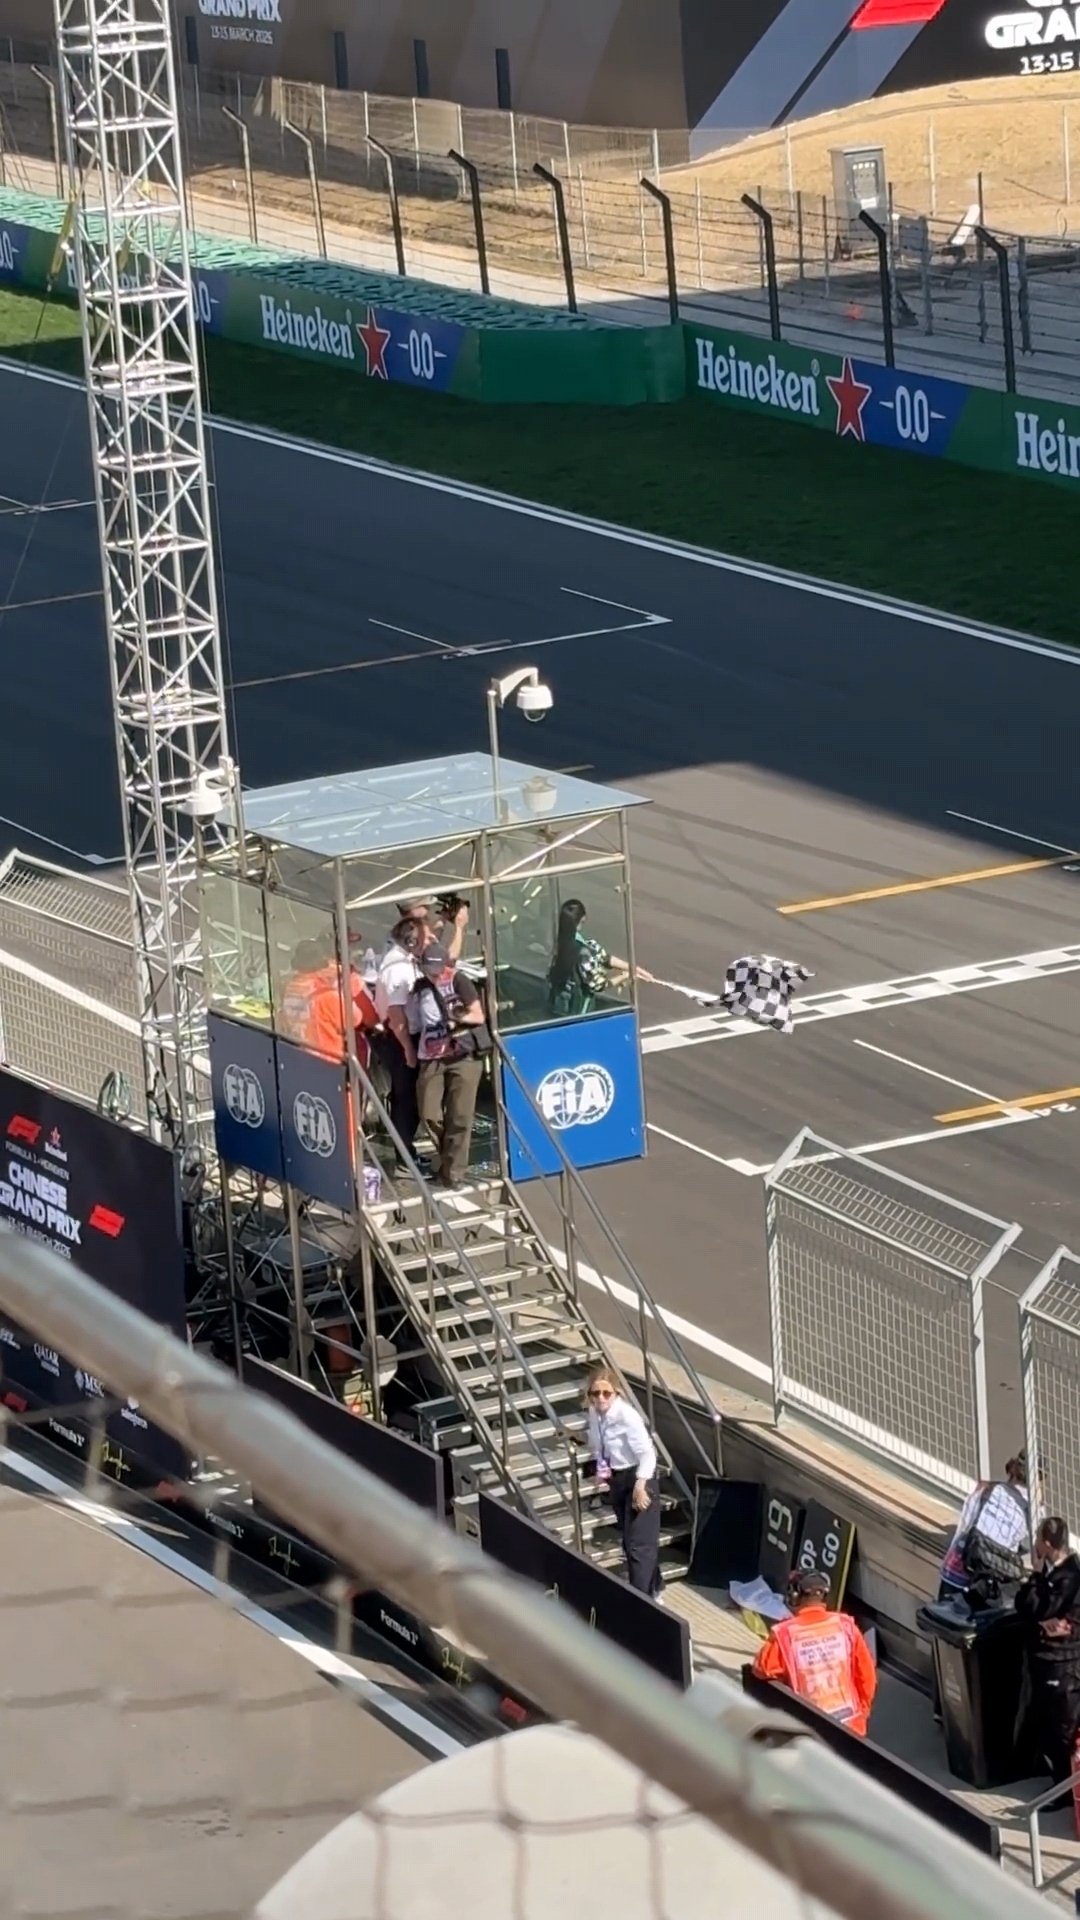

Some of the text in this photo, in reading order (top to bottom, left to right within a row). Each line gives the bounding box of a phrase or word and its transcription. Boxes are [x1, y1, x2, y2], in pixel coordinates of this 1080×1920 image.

[984, 6, 1080, 49] GRA
[1020, 52, 1075, 75] 13-15
[260, 294, 354, 360] Heineken
[695, 337, 820, 416] Heineken
[8, 1161, 67, 1211] CHINESE
[47, 1204, 81, 1245] PRIX
[822, 1532, 840, 1568] GO
